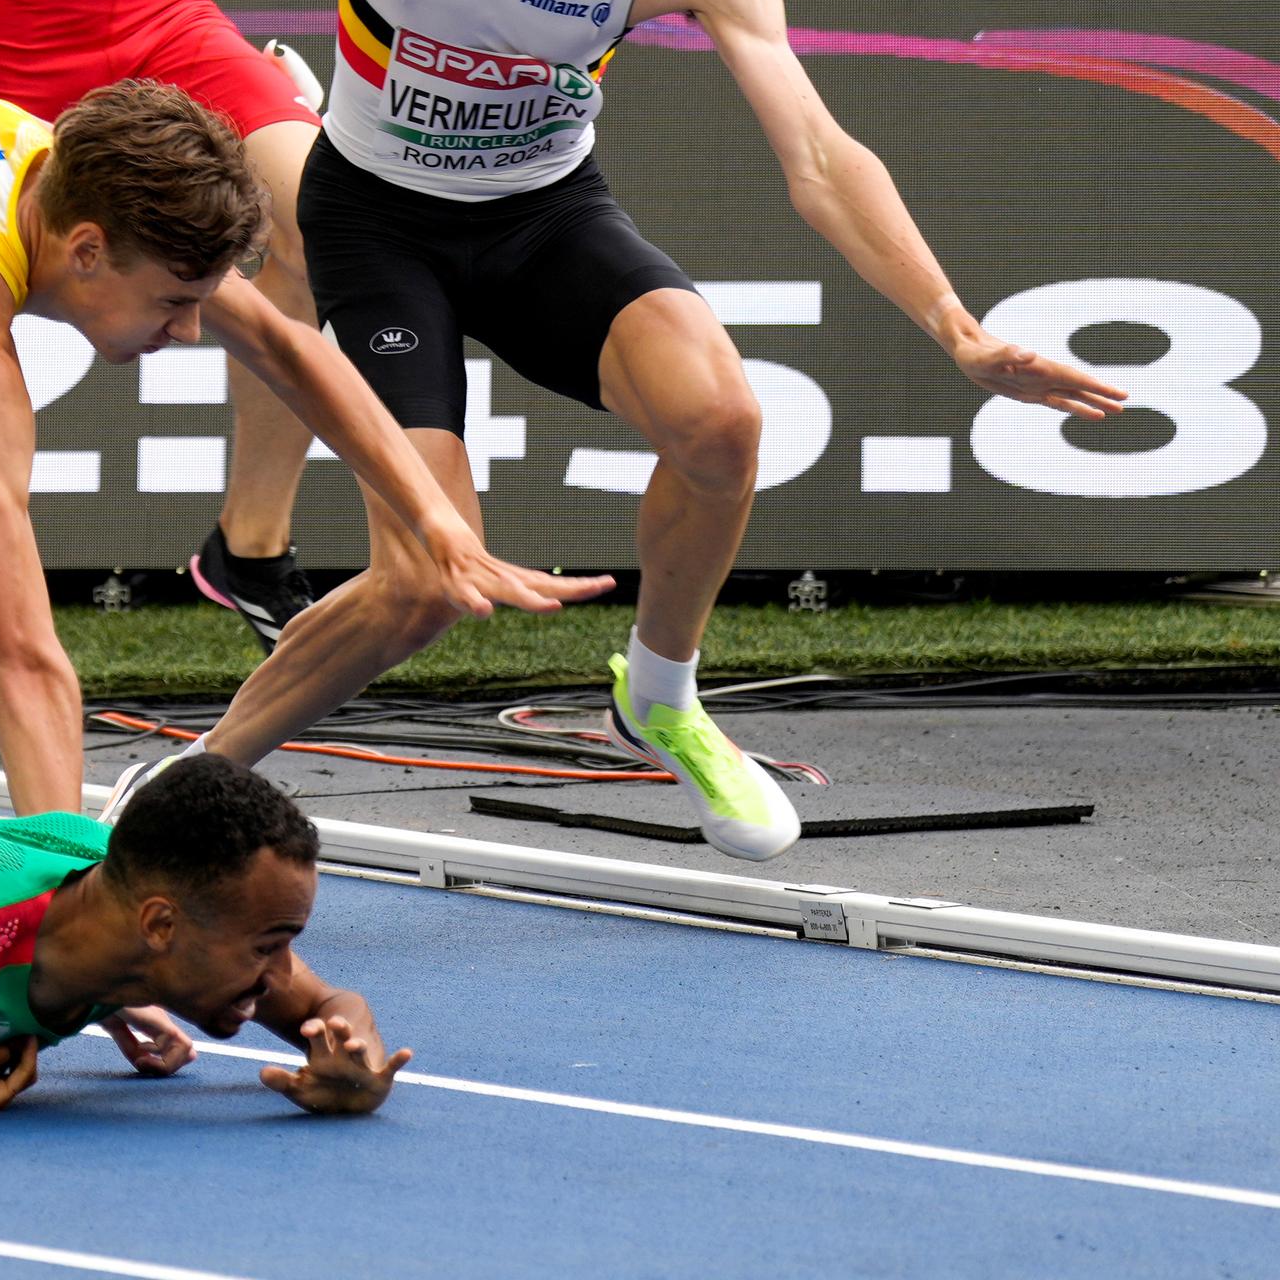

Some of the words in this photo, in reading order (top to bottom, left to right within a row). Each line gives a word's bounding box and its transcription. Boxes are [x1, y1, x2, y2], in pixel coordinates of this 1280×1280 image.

[400, 36, 548, 86] SPAR
[389, 79, 587, 130] VERMEULEN
[402, 146, 487, 170] ROMA
[493, 139, 553, 168] 2024
[429, 136, 475, 148] RUN
